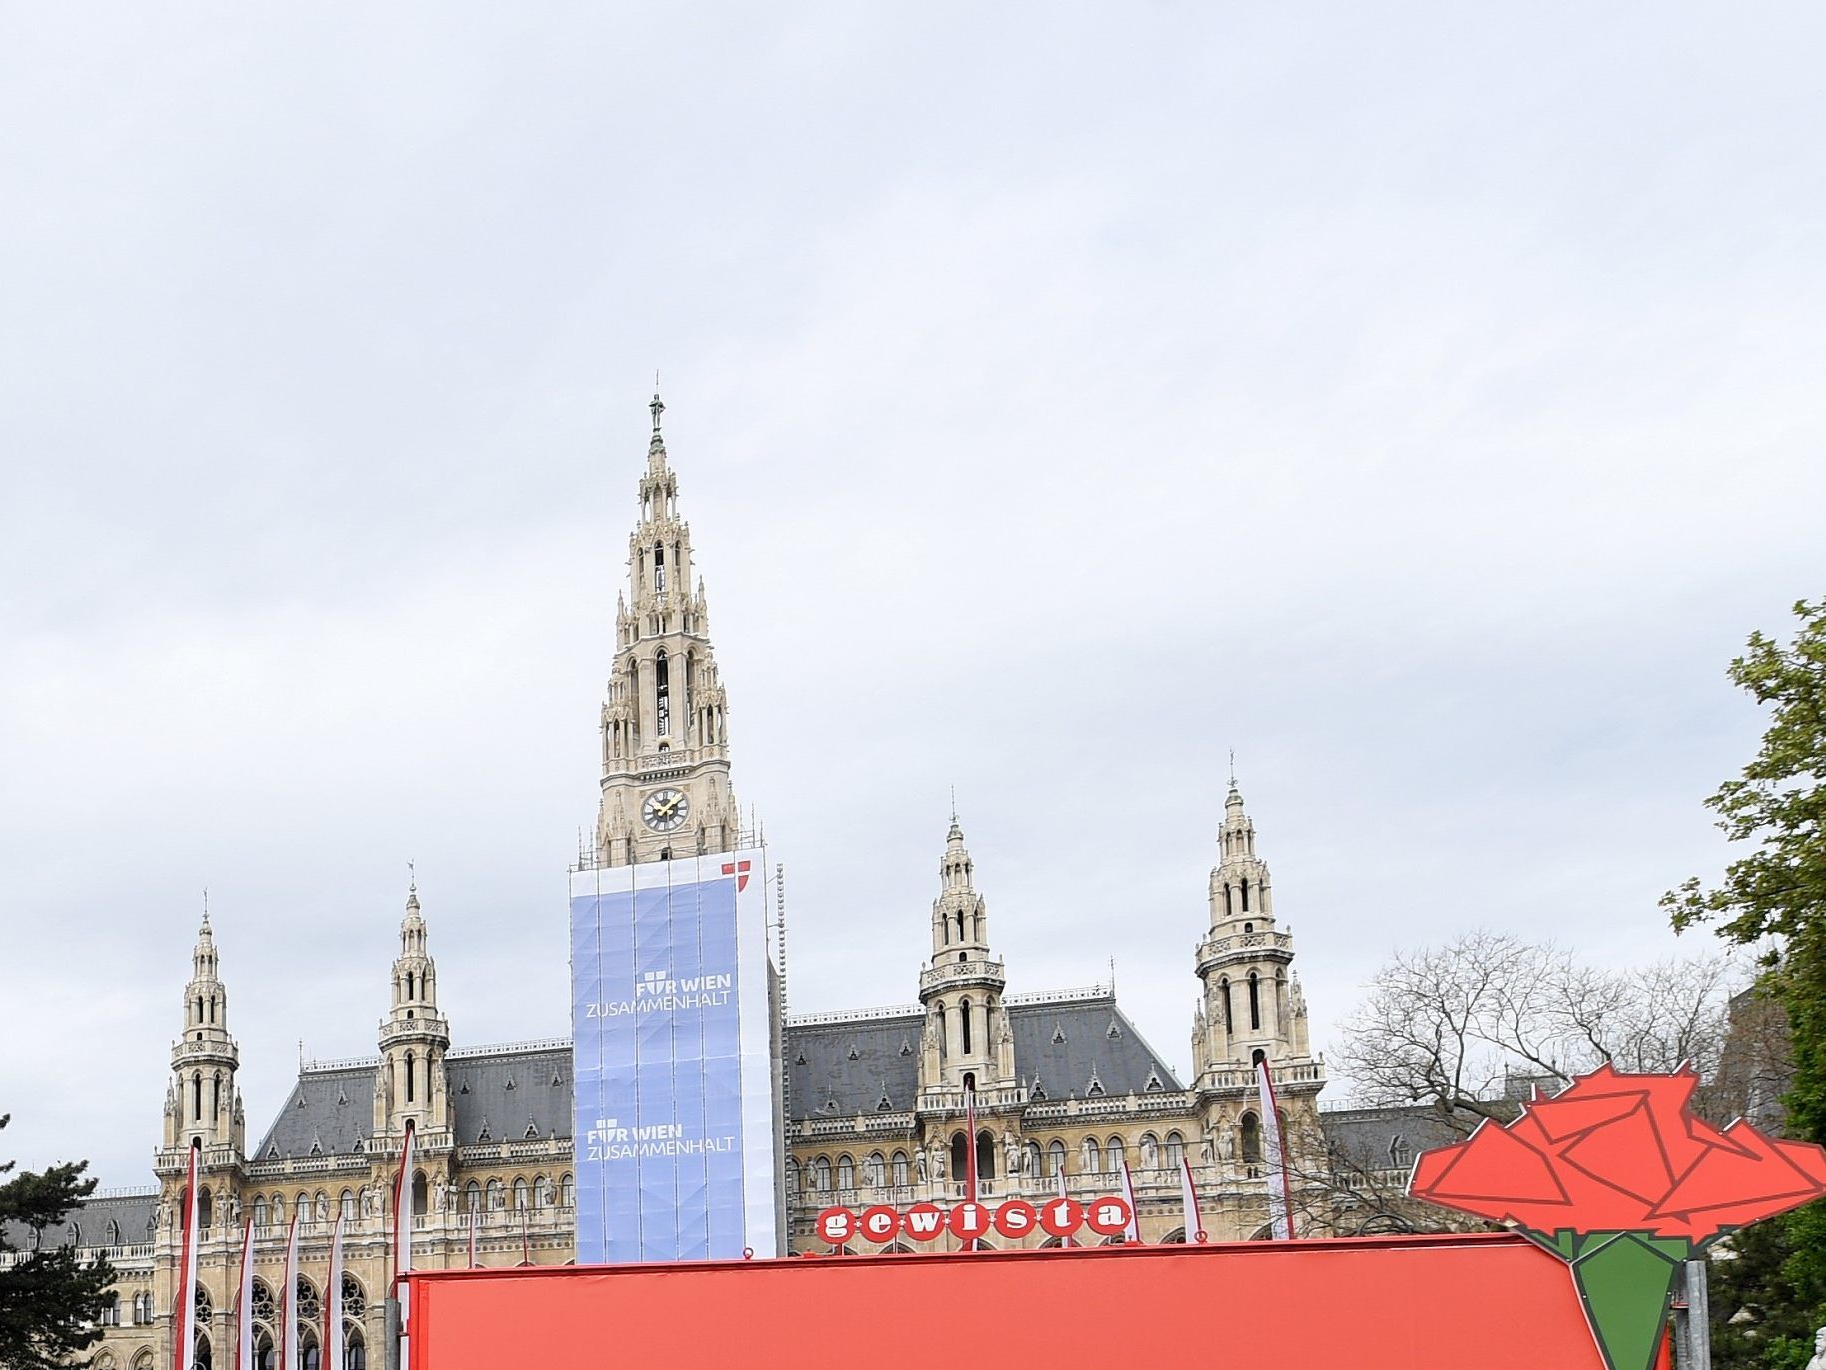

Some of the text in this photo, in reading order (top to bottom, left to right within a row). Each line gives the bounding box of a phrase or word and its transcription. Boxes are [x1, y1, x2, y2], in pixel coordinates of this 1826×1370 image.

[682, 974, 731, 992] WIEN
[586, 991, 731, 1018] ZUSAMMENHALT
[632, 1124, 682, 1141] WIEN
[588, 1137, 735, 1161] ZUSAMMENHALT
[826, 1199, 1128, 1239] gewista
